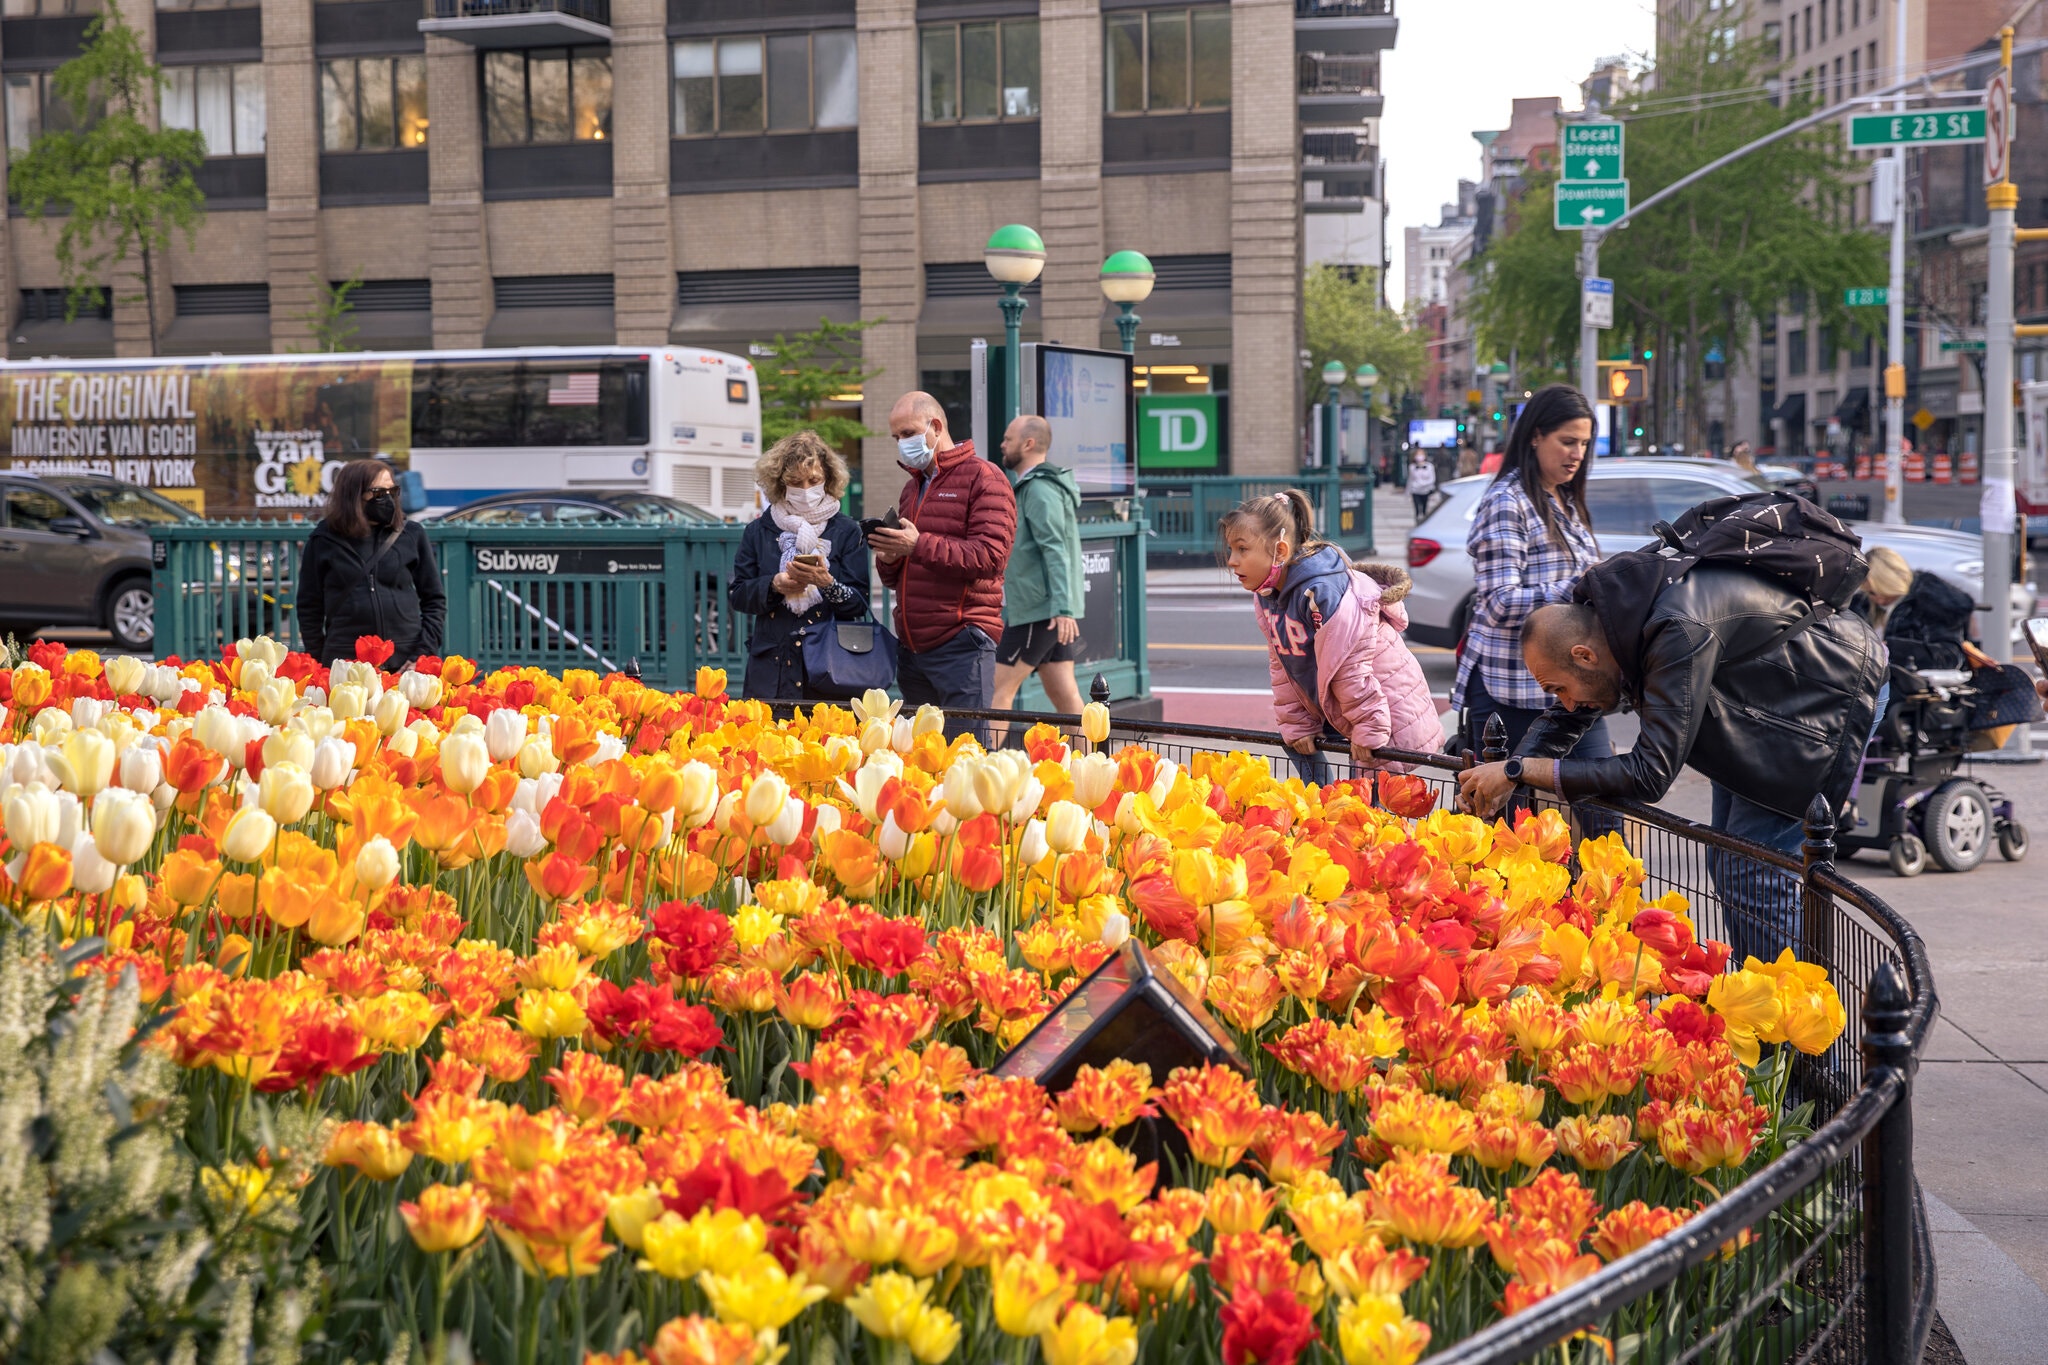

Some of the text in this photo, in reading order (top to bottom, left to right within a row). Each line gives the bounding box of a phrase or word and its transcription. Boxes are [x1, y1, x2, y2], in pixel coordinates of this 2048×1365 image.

[1569, 127, 1615, 142] Local
[1890, 113, 1970, 140] E 23 St
[1566, 143, 1620, 157] Streets
[1559, 187, 1625, 201] Downtown
[13, 374, 197, 422] THE ORIGINAL
[11, 424, 197, 457] IMMERSIVE VAN GOGH
[1147, 408, 1208, 452] TD
[113, 459, 151, 487] NEW
[151, 458, 197, 487] YORK
[477, 549, 559, 575] Subway
